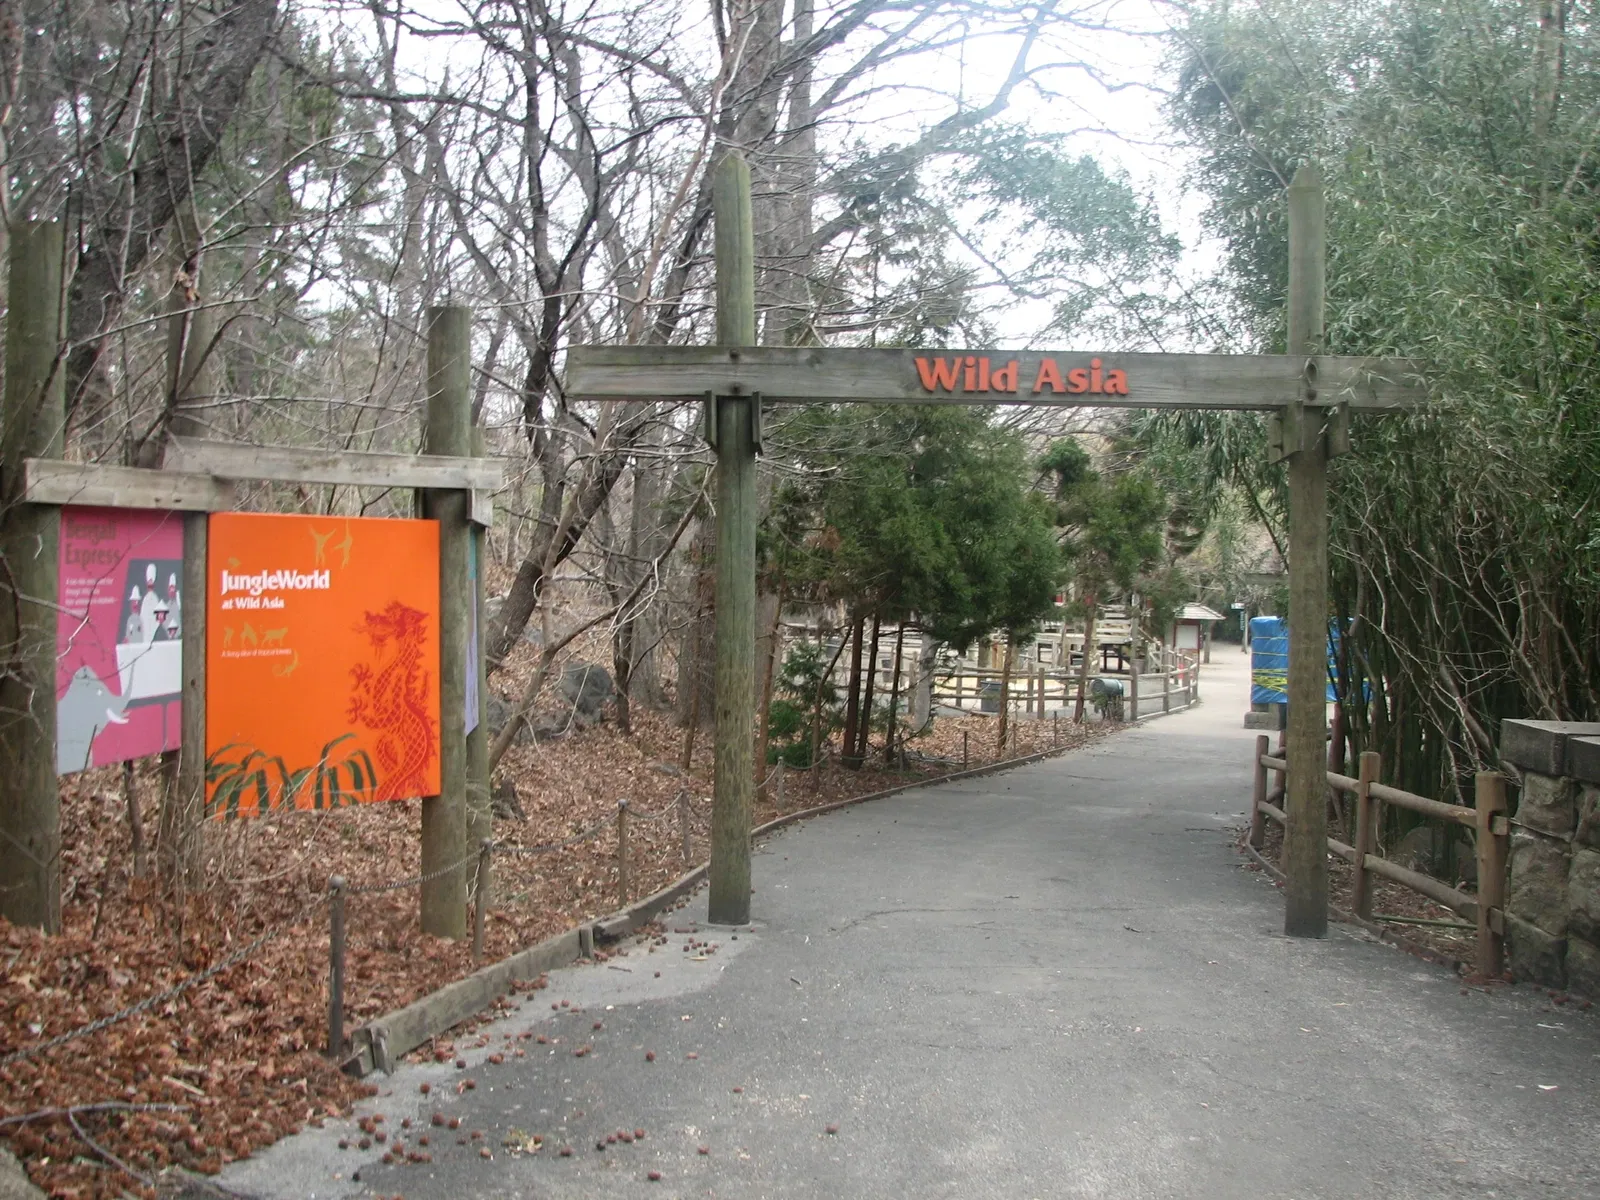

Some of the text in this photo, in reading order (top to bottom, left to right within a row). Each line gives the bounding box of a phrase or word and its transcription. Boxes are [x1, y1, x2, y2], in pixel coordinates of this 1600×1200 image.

[915, 356, 1129, 395] Wild Asia
[66, 543, 120, 569] Express
[220, 569, 331, 596] JungleWorld
[222, 596, 285, 610] at Wild Asia
